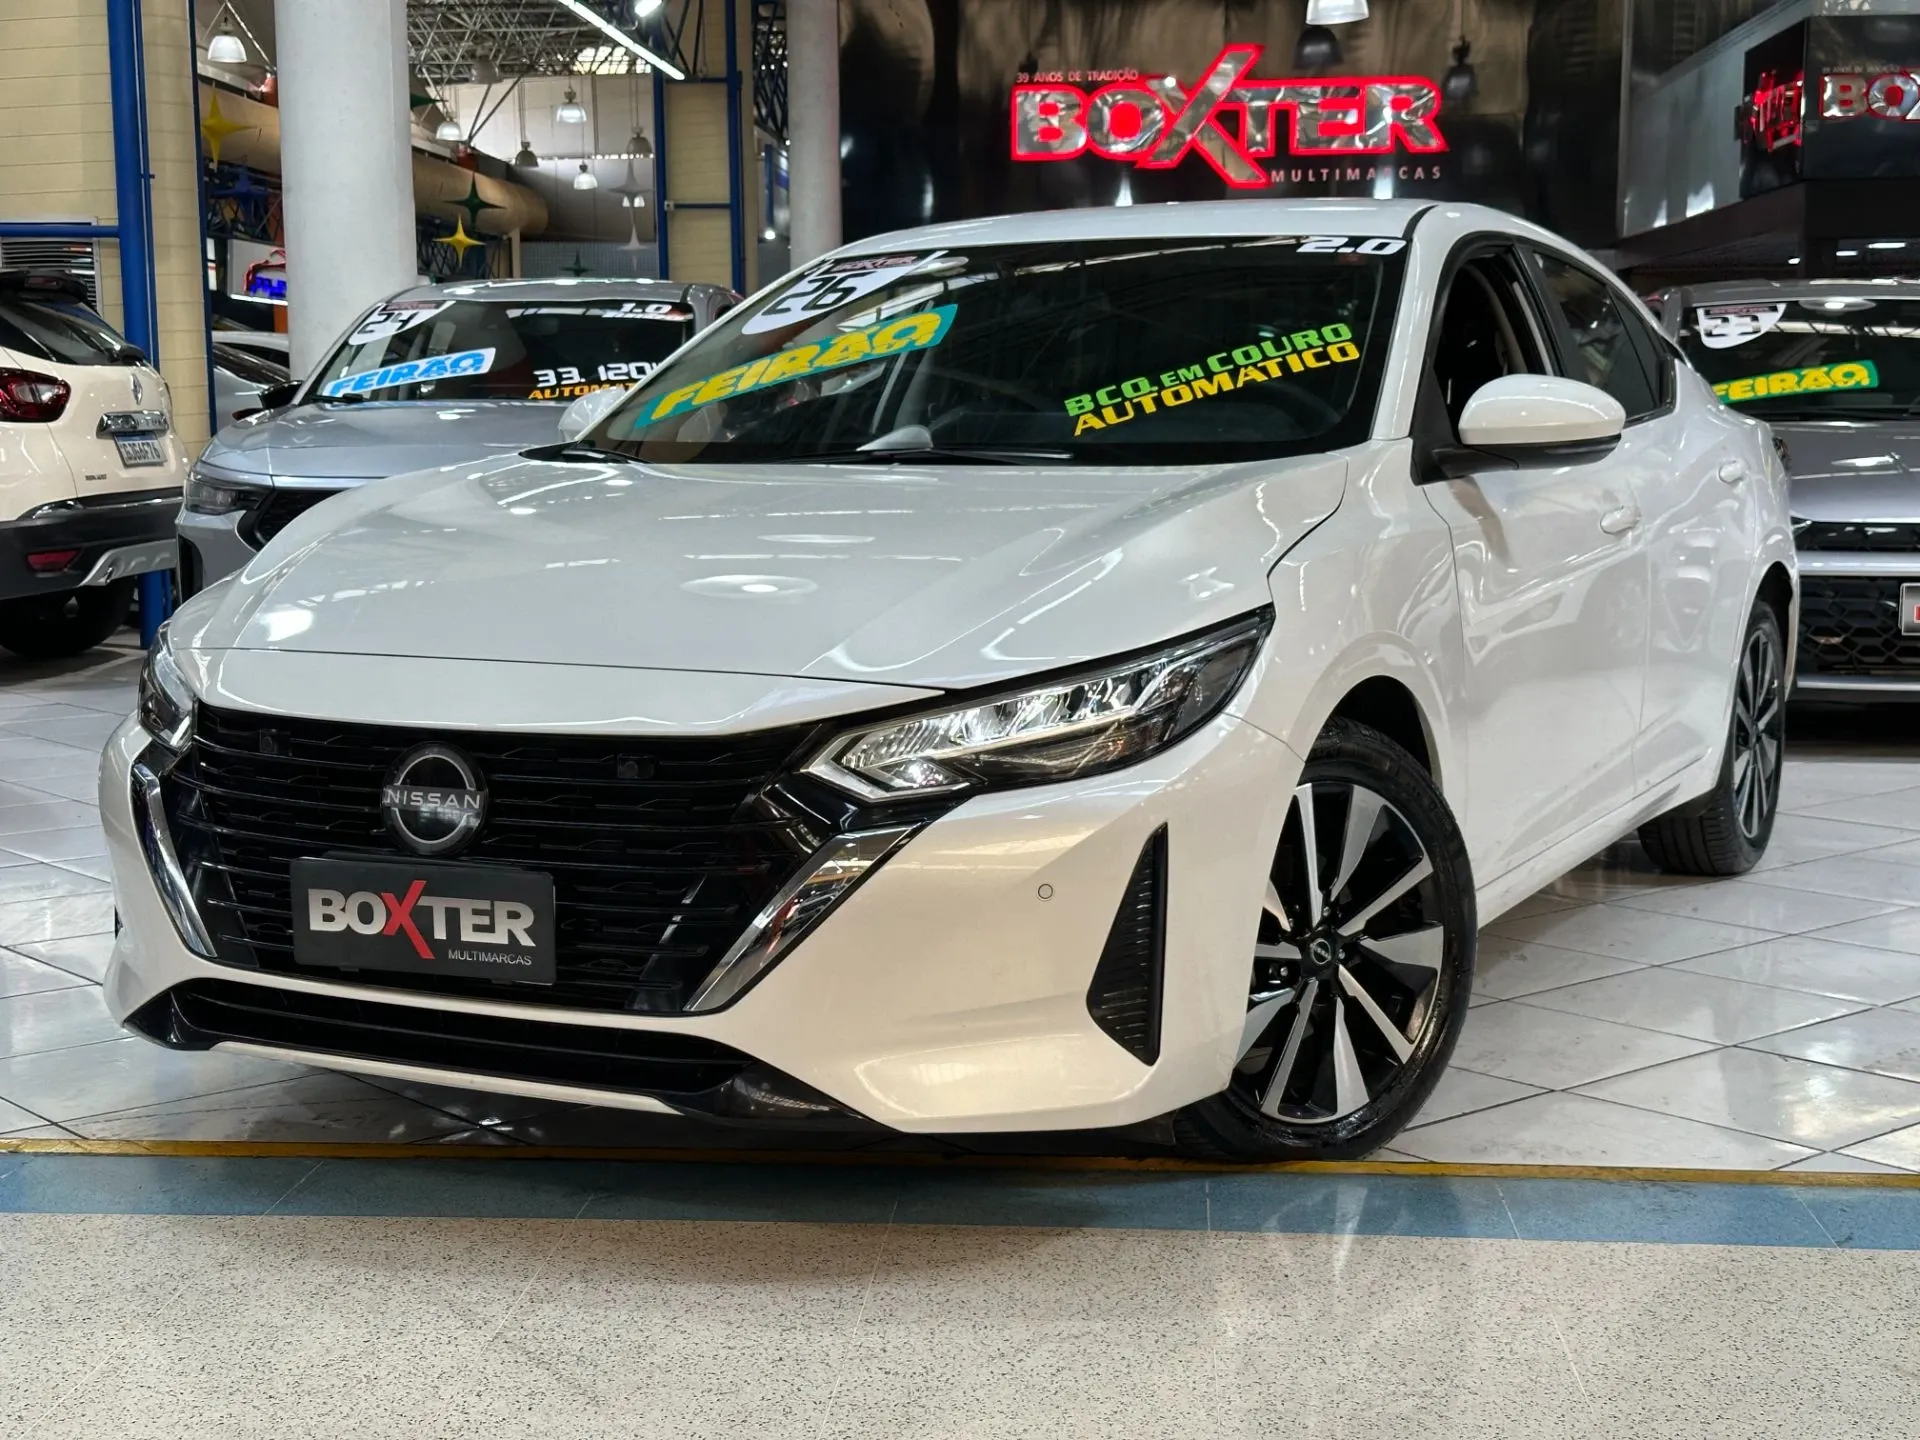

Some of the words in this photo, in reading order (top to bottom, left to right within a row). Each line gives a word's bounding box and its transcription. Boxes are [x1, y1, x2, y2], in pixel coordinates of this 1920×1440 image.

[1033, 71, 1063, 82] ANOS
[1068, 71, 1082, 82] DE
[1087, 68, 1139, 82] TRADIÇÃO
[1011, 43, 1449, 189] BOXTER
[1271, 166, 1441, 183] MULTIMARCAS
[1296, 236, 1407, 256] 2.0
[761, 271, 878, 316] 26
[620, 302, 673, 314] 1.0
[357, 311, 419, 334] 24
[1160, 364, 1203, 388] EM
[1206, 323, 1352, 373] COURO
[1073, 341, 1360, 436] AUTOMATICO
[387, 788, 480, 809] NISSAN
[308, 880, 536, 959] BOXTER
[448, 949, 533, 966] MULTIMARCAS
